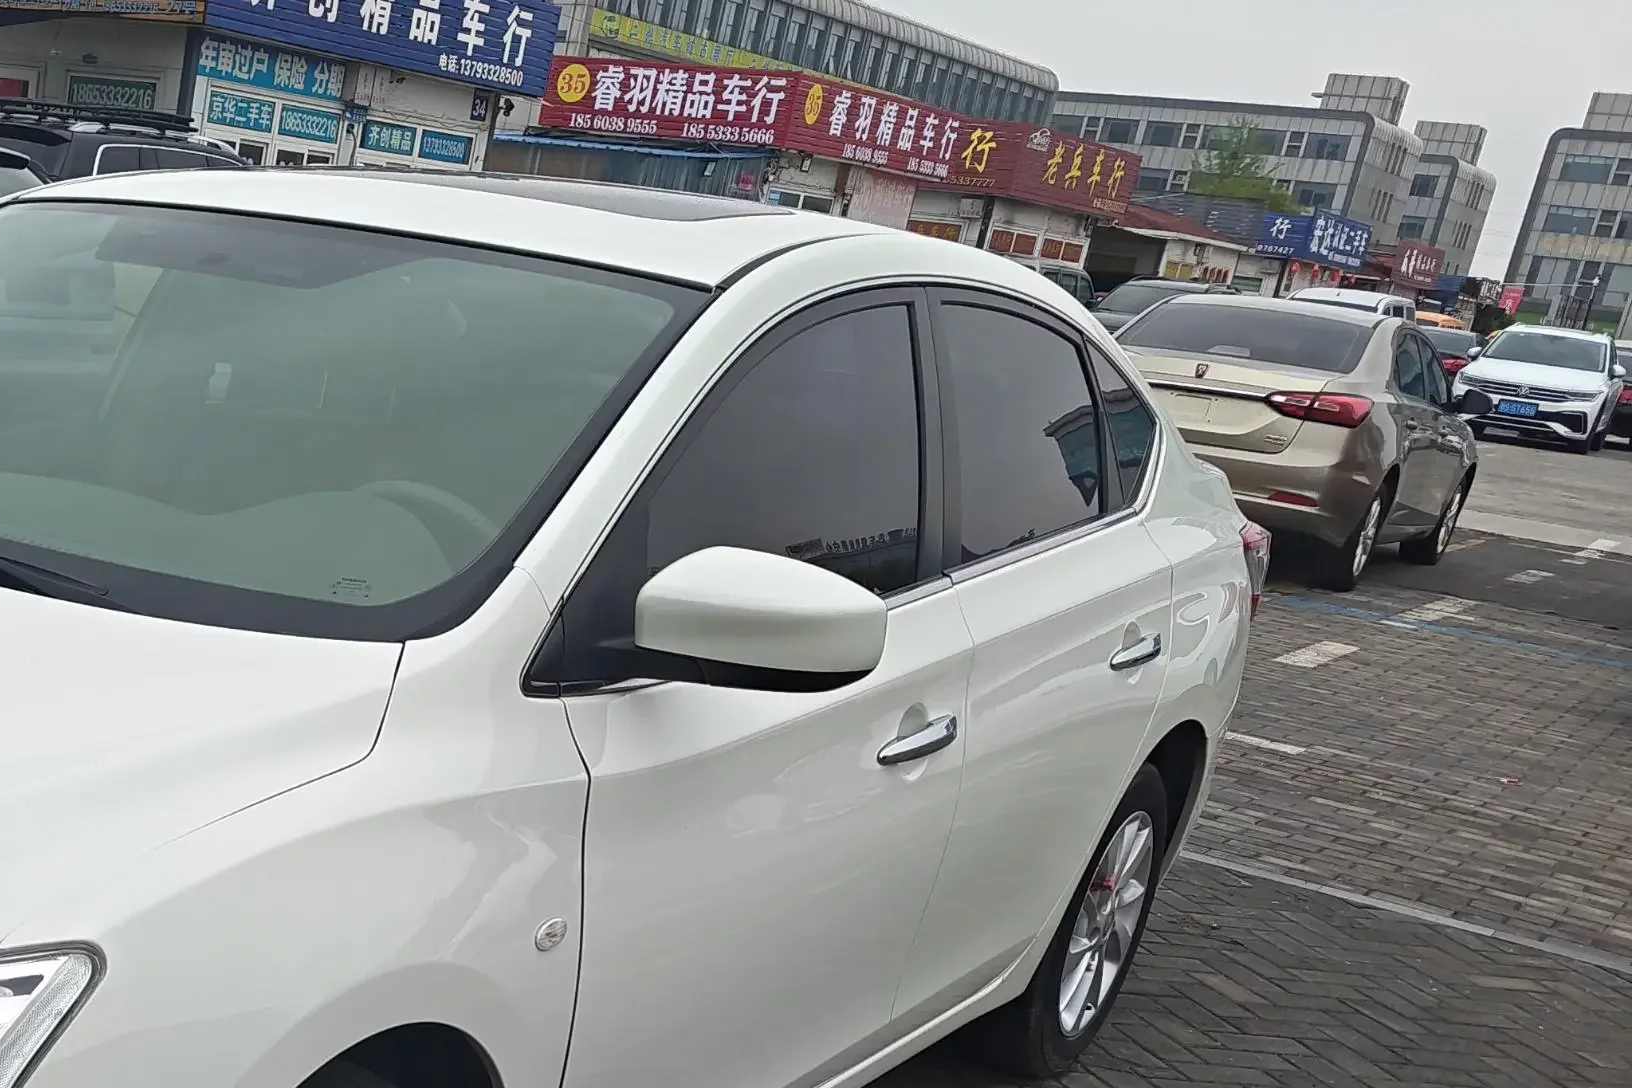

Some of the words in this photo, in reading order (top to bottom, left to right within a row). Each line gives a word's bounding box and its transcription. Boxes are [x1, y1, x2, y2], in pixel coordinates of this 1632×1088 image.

[250, 0, 534, 67] 创精品车行
[198, 36, 270, 80] 年审过户
[274, 52, 308, 90] 保险
[312, 61, 346, 98] 分期
[71, 83, 153, 109] 18653332216
[560, 72, 589, 94] 35
[591, 64, 787, 125] 睿羽精品车行
[210, 96, 273, 129] 京华二手车
[473, 100, 486, 117] 34
[281, 110, 337, 139] 18653332216
[569, 113, 592, 128] 185
[593, 115, 625, 132] 6038
[626, 119, 658, 134] 9555
[681, 122, 705, 139] 185
[706, 125, 741, 142] 5333
[741, 128, 775, 145] 5666
[829, 89, 960, 161] 睿羽精品车行
[368, 125, 412, 151] 齐创精品
[423, 136, 465, 158] 13793328500
[961, 128, 998, 173] 行
[1270, 217, 1292, 240] 行
